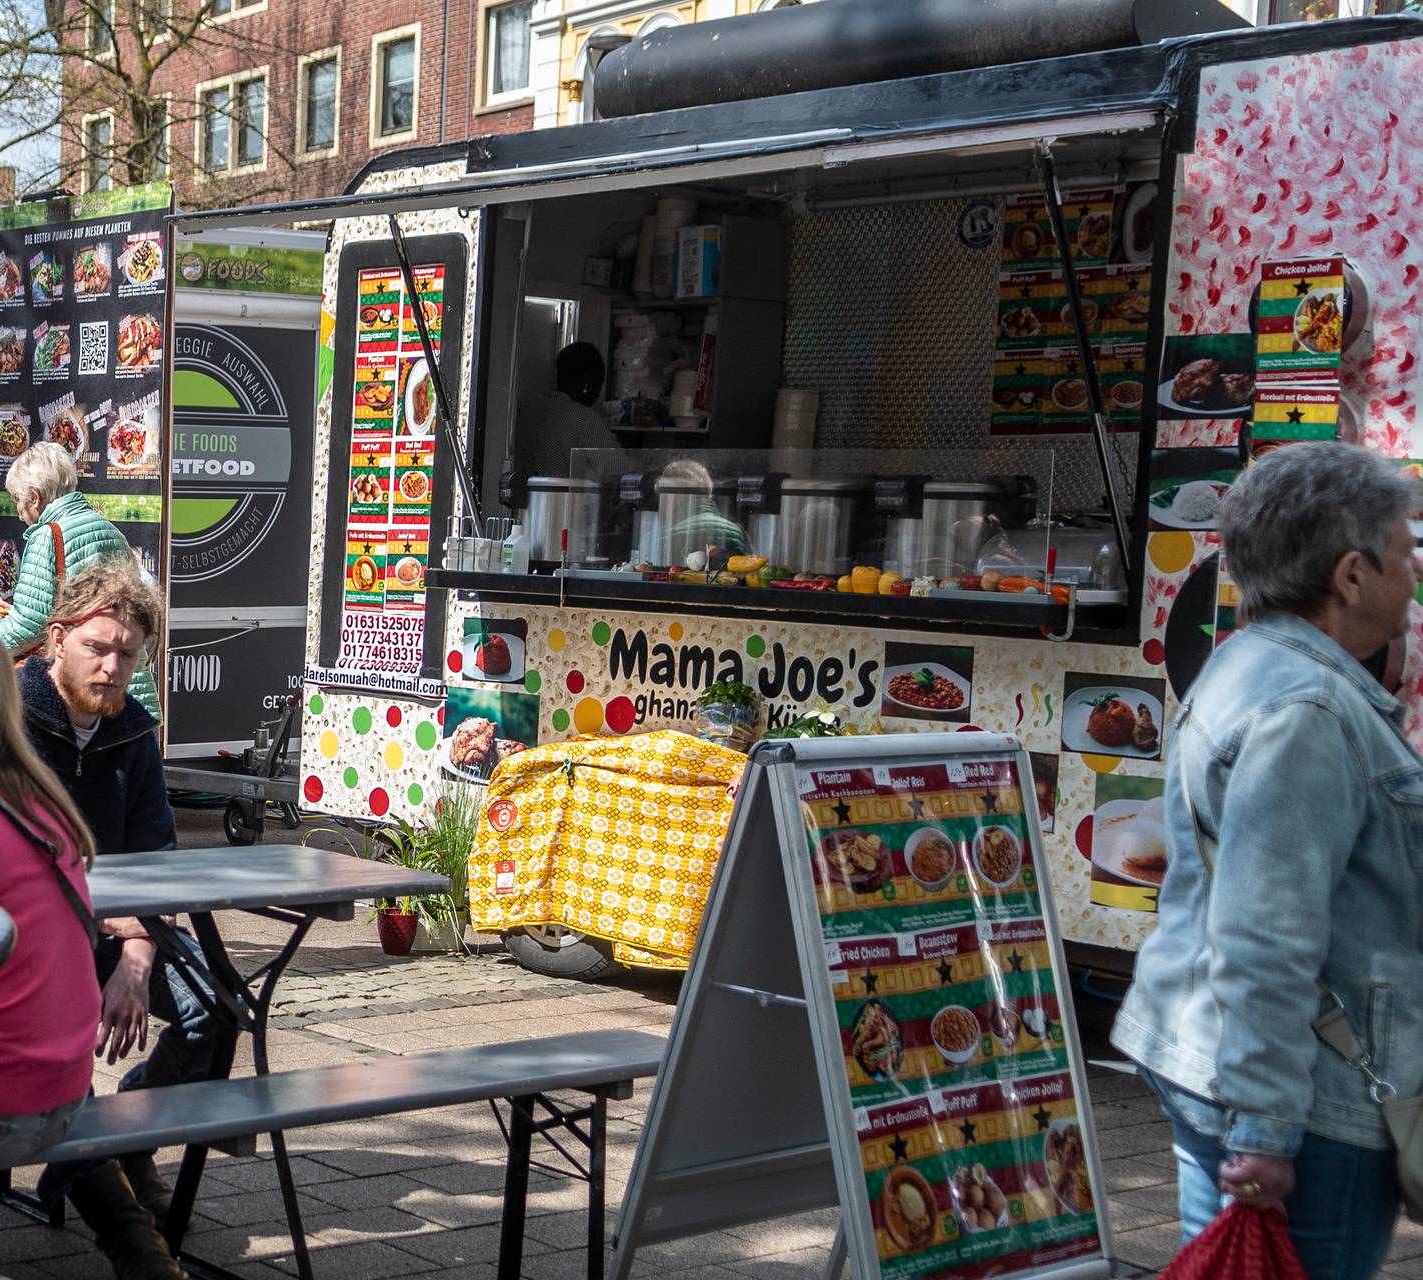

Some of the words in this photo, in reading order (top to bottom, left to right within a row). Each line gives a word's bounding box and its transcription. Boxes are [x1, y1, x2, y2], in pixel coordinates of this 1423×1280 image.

[25, 234, 33, 245] DIE
[33, 231, 51, 244] BESTEN
[52, 229, 73, 242] POMMES
[74, 226, 84, 239] AUF
[85, 224, 103, 237] DIESEM
[104, 221, 132, 236] PLANETEN
[208, 257, 269, 285] FOODS
[1274, 265, 1306, 276] Chicken
[1307, 262, 1331, 274] Jollof
[222, 352, 270, 411] AUSWAHL
[193, 434, 238, 453] FOODS
[346, 614, 424, 632] 01631525078
[342, 629, 421, 647] 01727343137
[344, 644, 422, 661] 01774618315
[609, 628, 743, 691] Mama
[758, 641, 879, 708] Joe's
[817, 771, 852, 785] Plantain
[964, 764, 979, 777] Red
[980, 763, 994, 777] Red
[911, 775, 925, 788] Reis
[919, 933, 958, 949] Beansstew
[861, 945, 890, 960] Chicken
[961, 1093, 977, 1109] Puff
